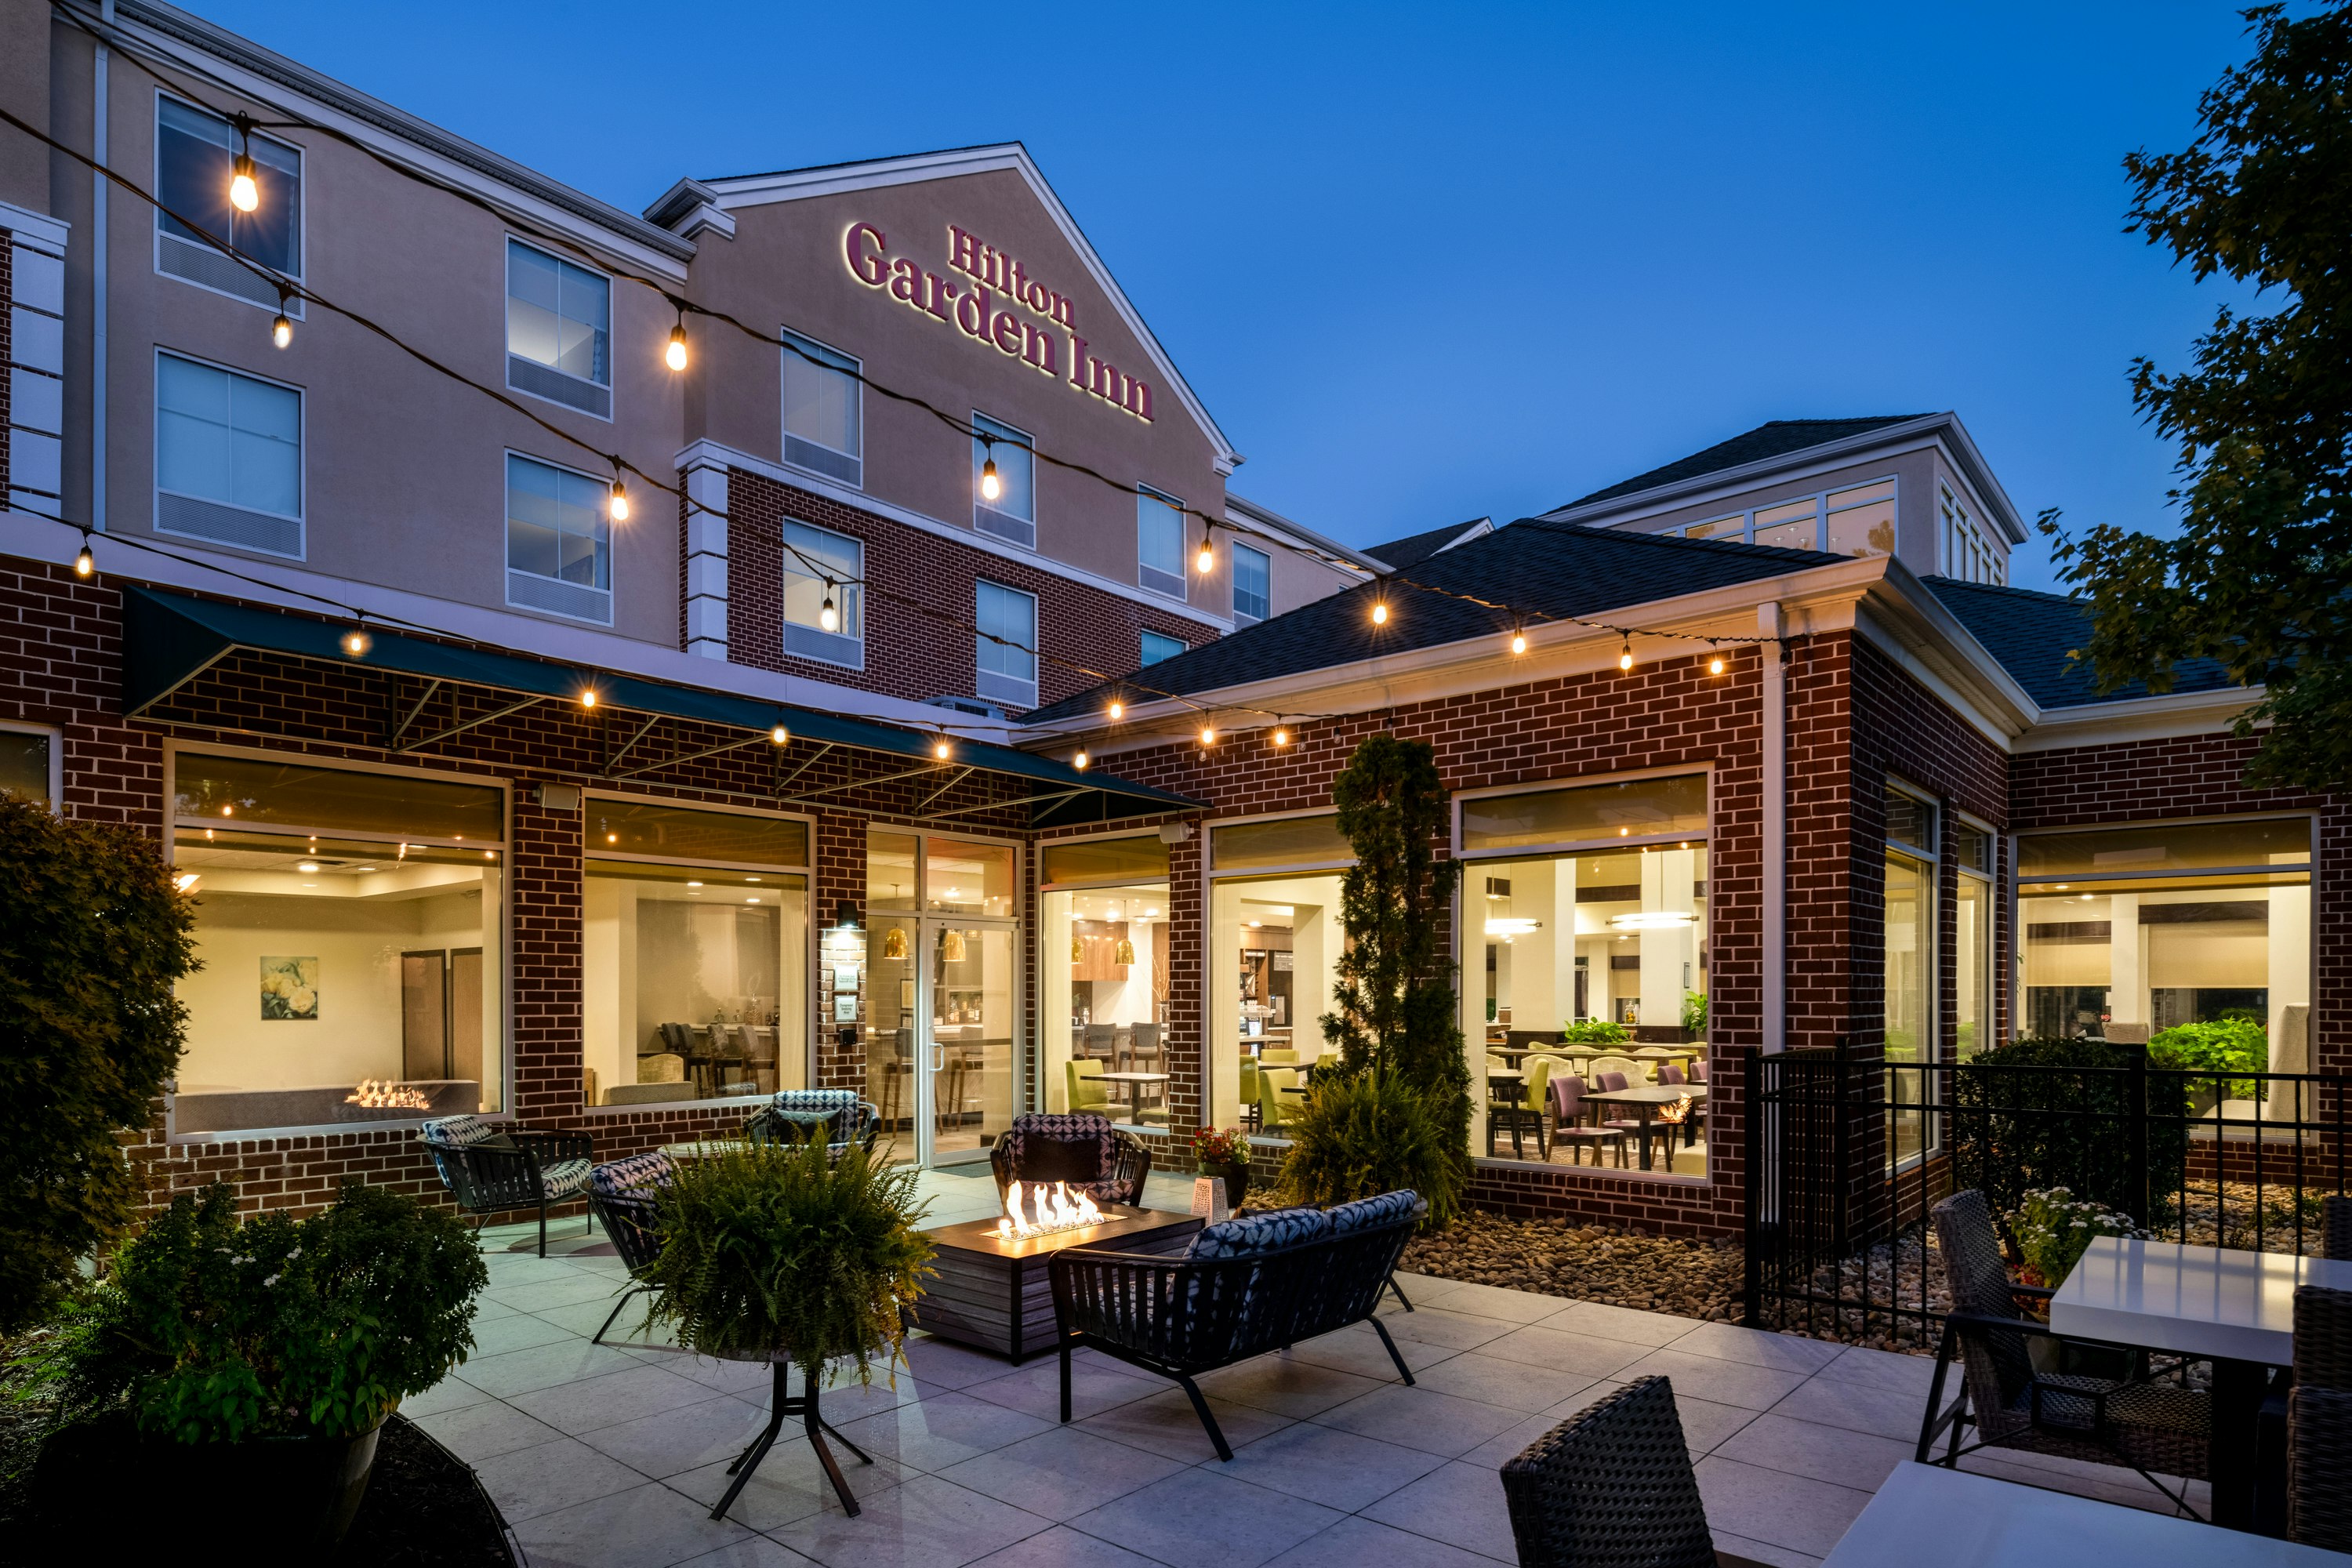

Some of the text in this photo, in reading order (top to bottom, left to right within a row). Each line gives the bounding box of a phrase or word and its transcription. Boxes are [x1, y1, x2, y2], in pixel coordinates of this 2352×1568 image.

[846, 222, 1155, 422] Garden Inn
[949, 224, 1076, 330] Hilton
